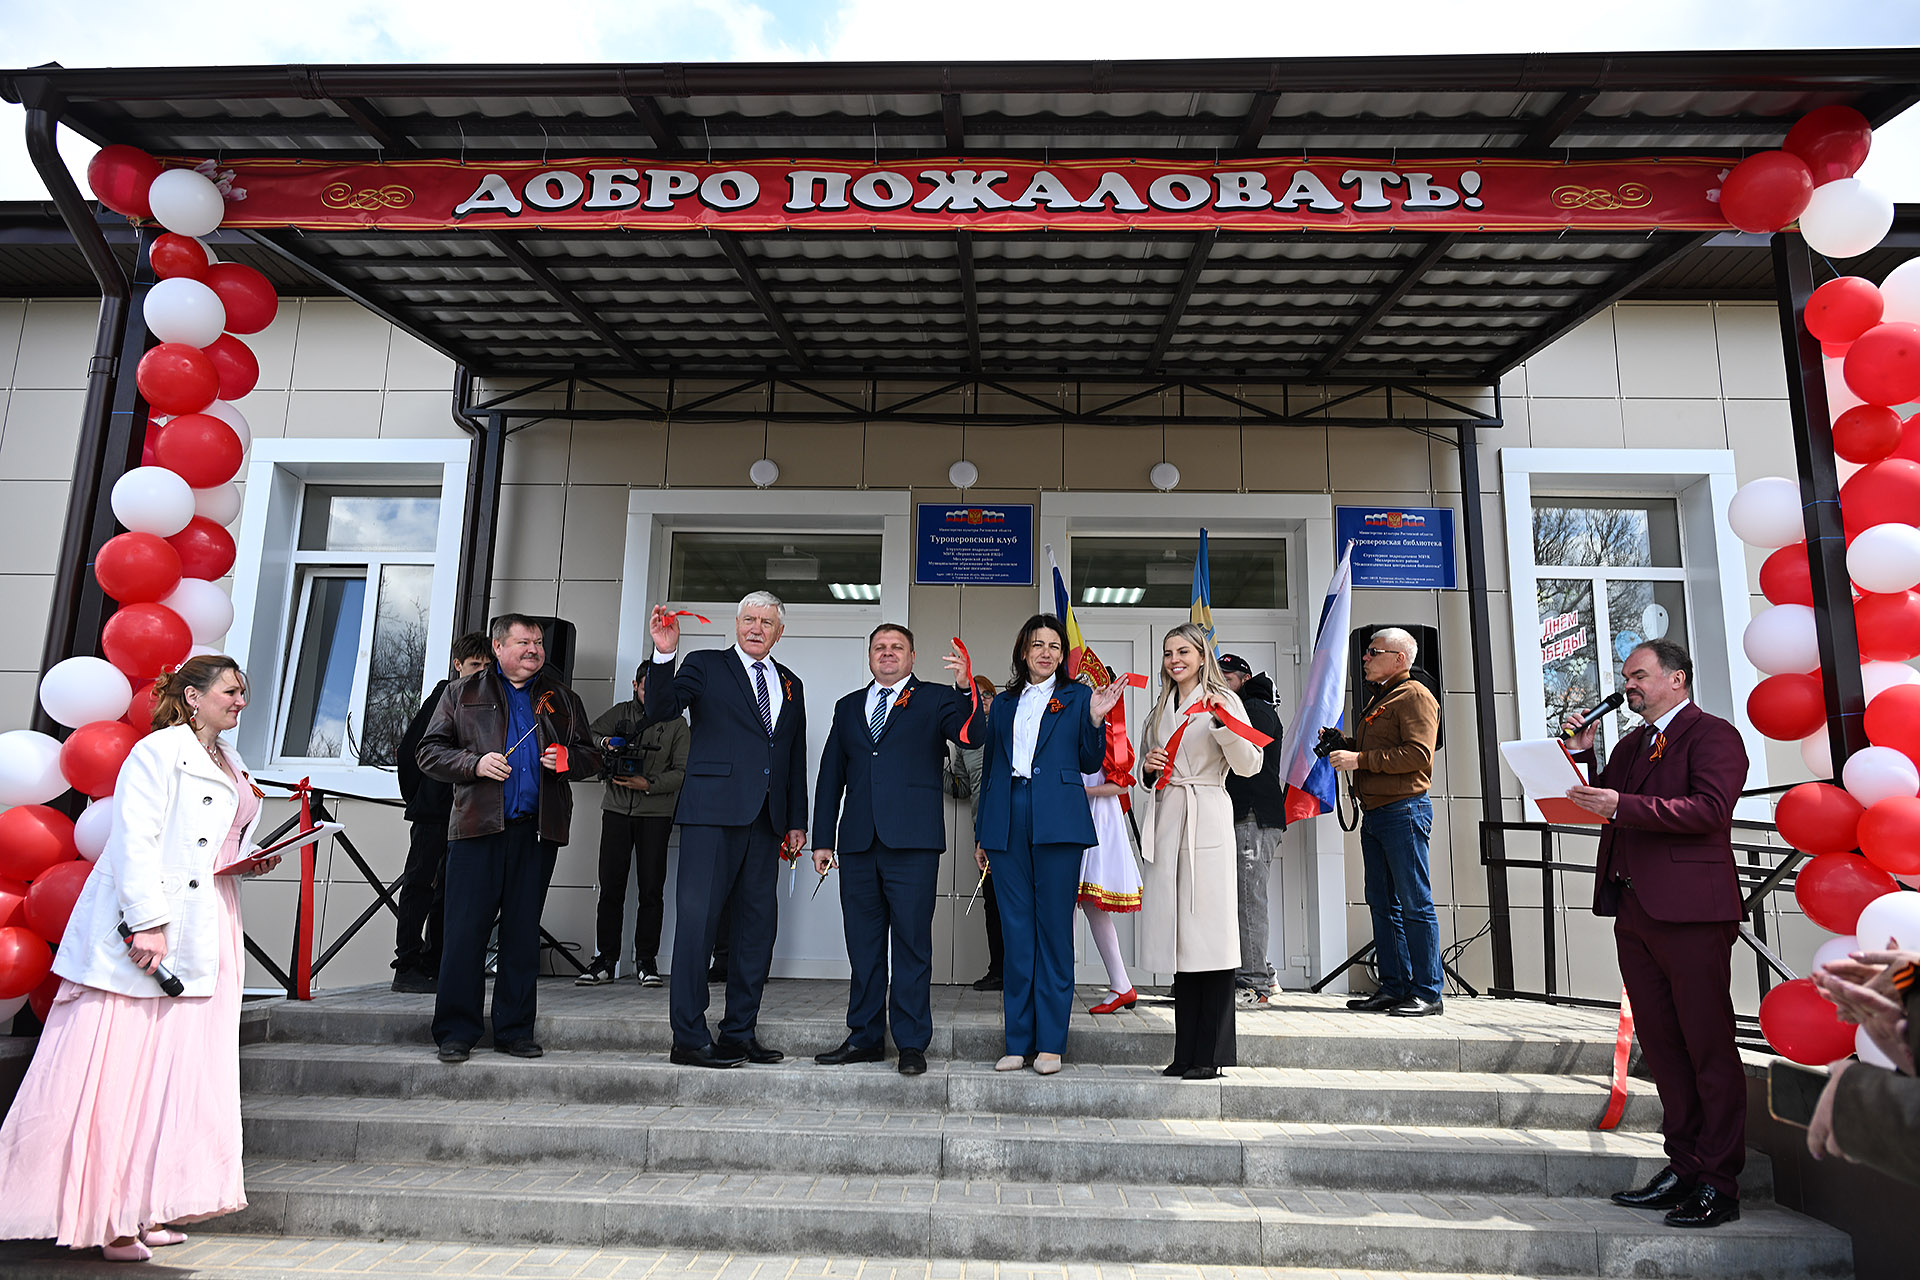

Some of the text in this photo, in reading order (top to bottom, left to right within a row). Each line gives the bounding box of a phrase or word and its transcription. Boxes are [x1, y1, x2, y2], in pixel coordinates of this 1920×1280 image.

[455, 168, 1486, 216] ДОБРО ПОЖАЛОВАТЬ!
[930, 535, 1018, 545] Туроверовский клуб
[1403, 538, 1443, 547] библиотека
[1542, 611, 1577, 641] ДНЁМ
[1541, 628, 1587, 663] ОБЕДЫ!
